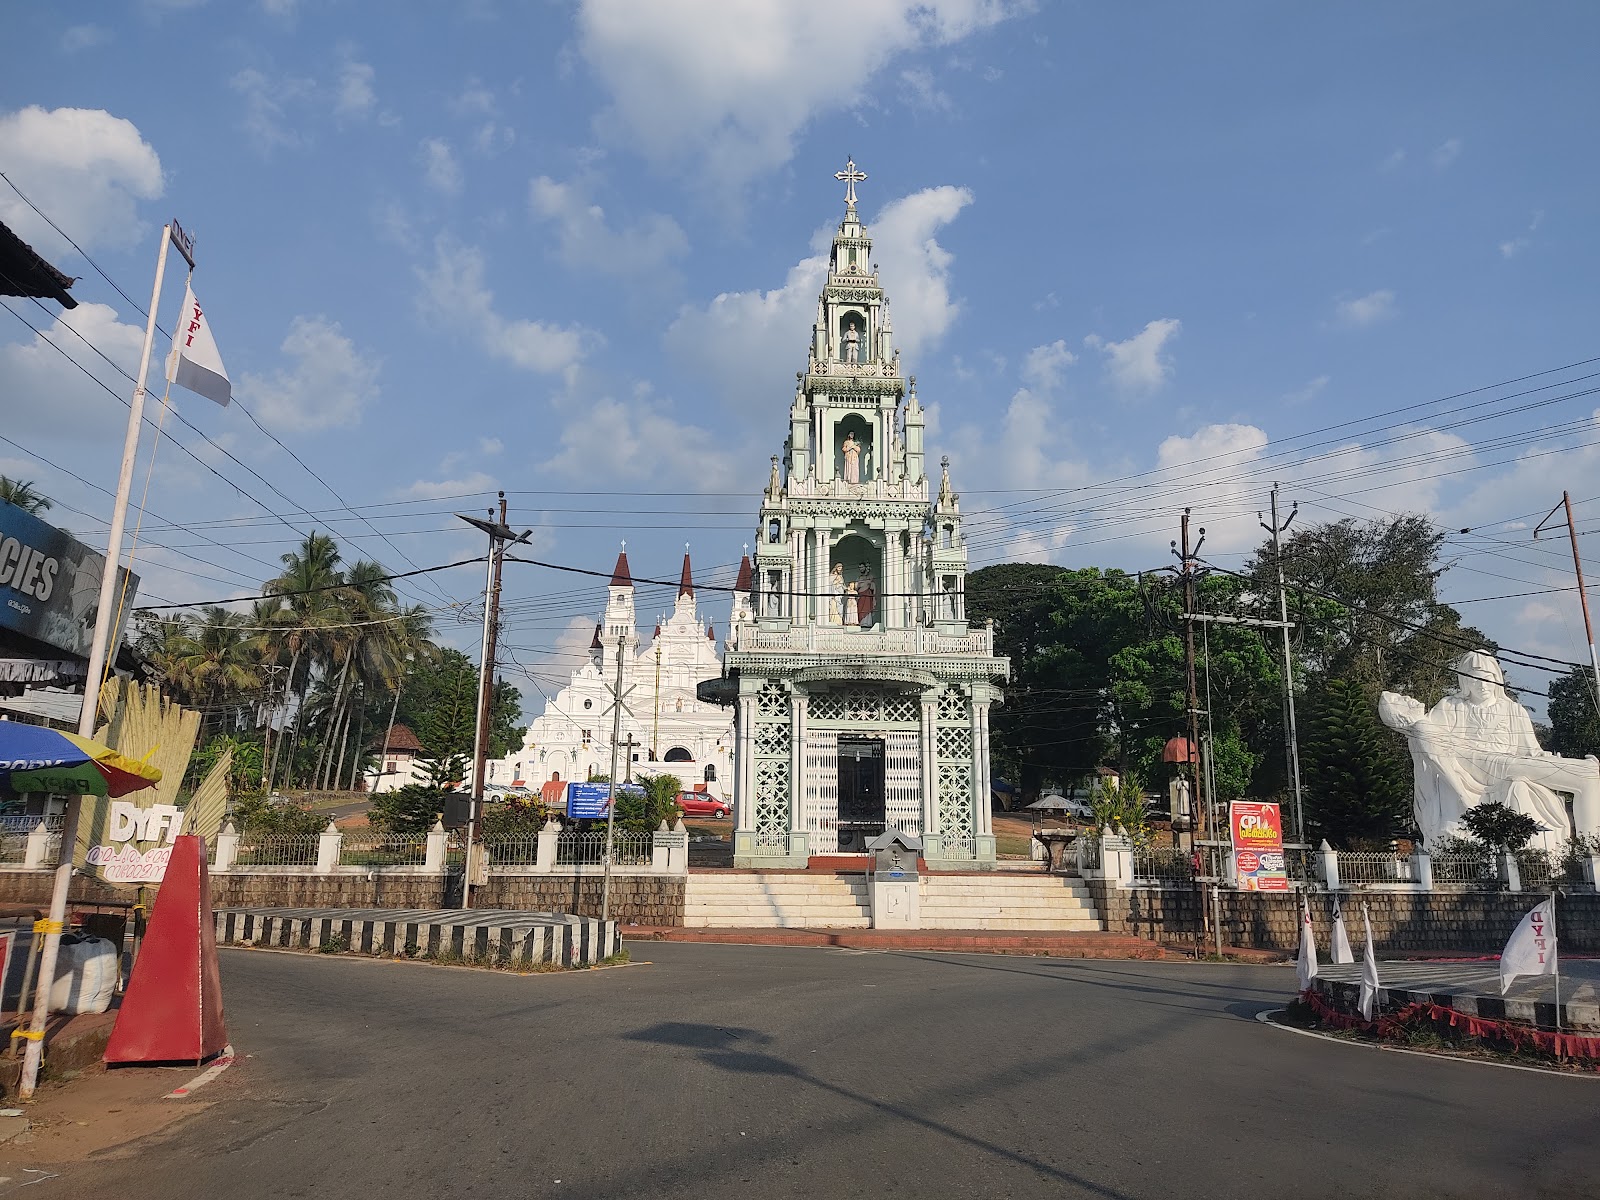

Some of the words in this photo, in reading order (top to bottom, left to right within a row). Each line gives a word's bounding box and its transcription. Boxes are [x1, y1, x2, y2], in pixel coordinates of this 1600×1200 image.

[0, 532, 59, 602] CIES
[109, 801, 184, 845] DYFI
[1240, 815, 1261, 829] CPI
